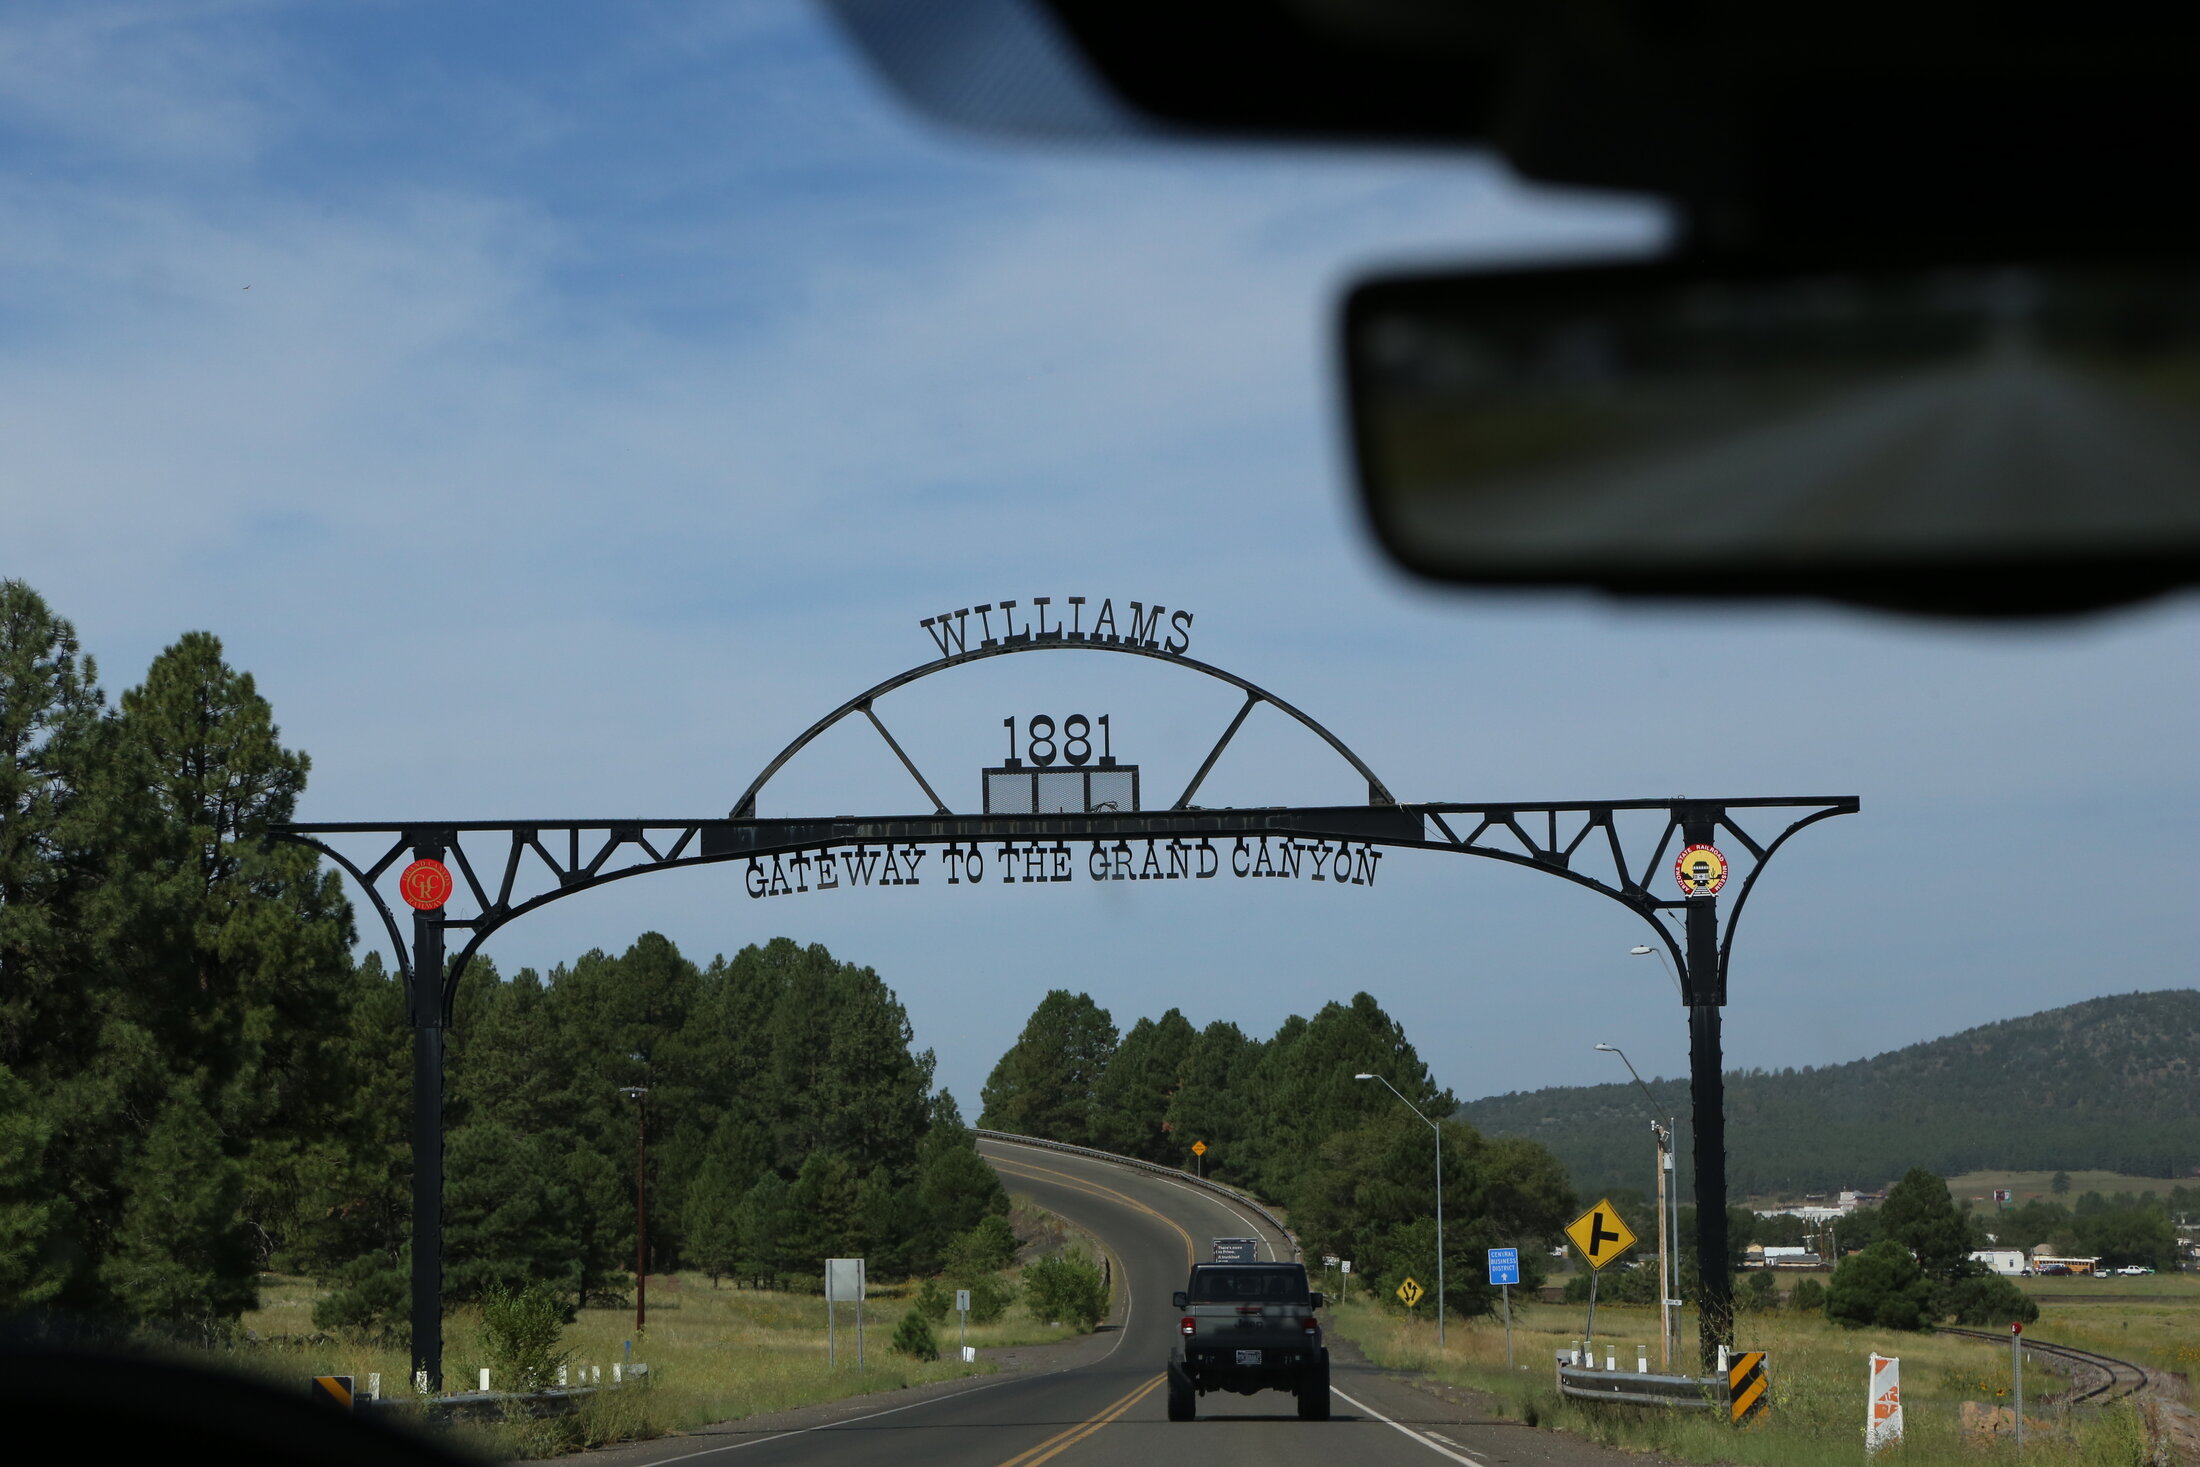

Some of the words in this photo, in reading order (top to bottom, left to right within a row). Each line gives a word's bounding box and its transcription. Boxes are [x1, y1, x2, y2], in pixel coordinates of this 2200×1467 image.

[920, 597, 1194, 658] WILLIAMS
[1004, 714, 1116, 768] 1881
[1677, 847, 1693, 864] STATE
[1696, 844, 1725, 862] RAILROAD
[403, 861, 426, 881] GRAND
[428, 861, 451, 886] CANYON
[746, 848, 926, 899] GATEWAY
[943, 848, 984, 883] TO
[998, 847, 1072, 883] THE
[1089, 844, 1219, 882] GRAND
[1232, 842, 1383, 887] CANYON
[1675, 867, 1690, 892] ARIZONA
[1714, 865, 1728, 891] MUSEUM
[407, 897, 443, 909] RAILWAY
[1234, 1318, 1264, 1330] Jeep
